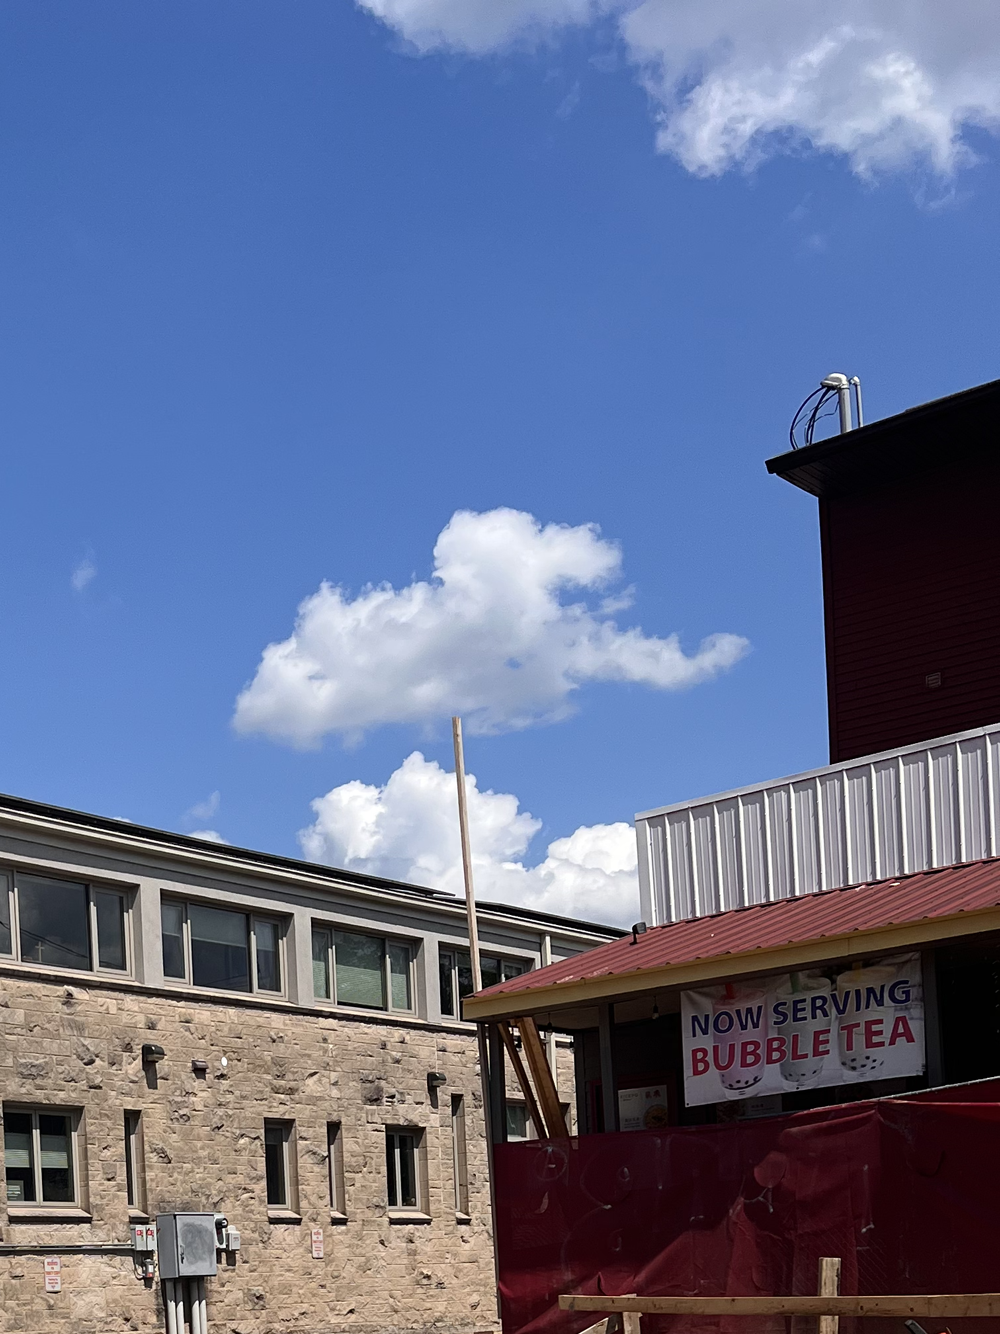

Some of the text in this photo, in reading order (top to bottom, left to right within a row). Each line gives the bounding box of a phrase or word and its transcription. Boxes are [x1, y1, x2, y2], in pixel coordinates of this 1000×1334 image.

[691, 979, 911, 1038] NOW SERVING
[691, 1015, 916, 1077] BUBBLE TEA
